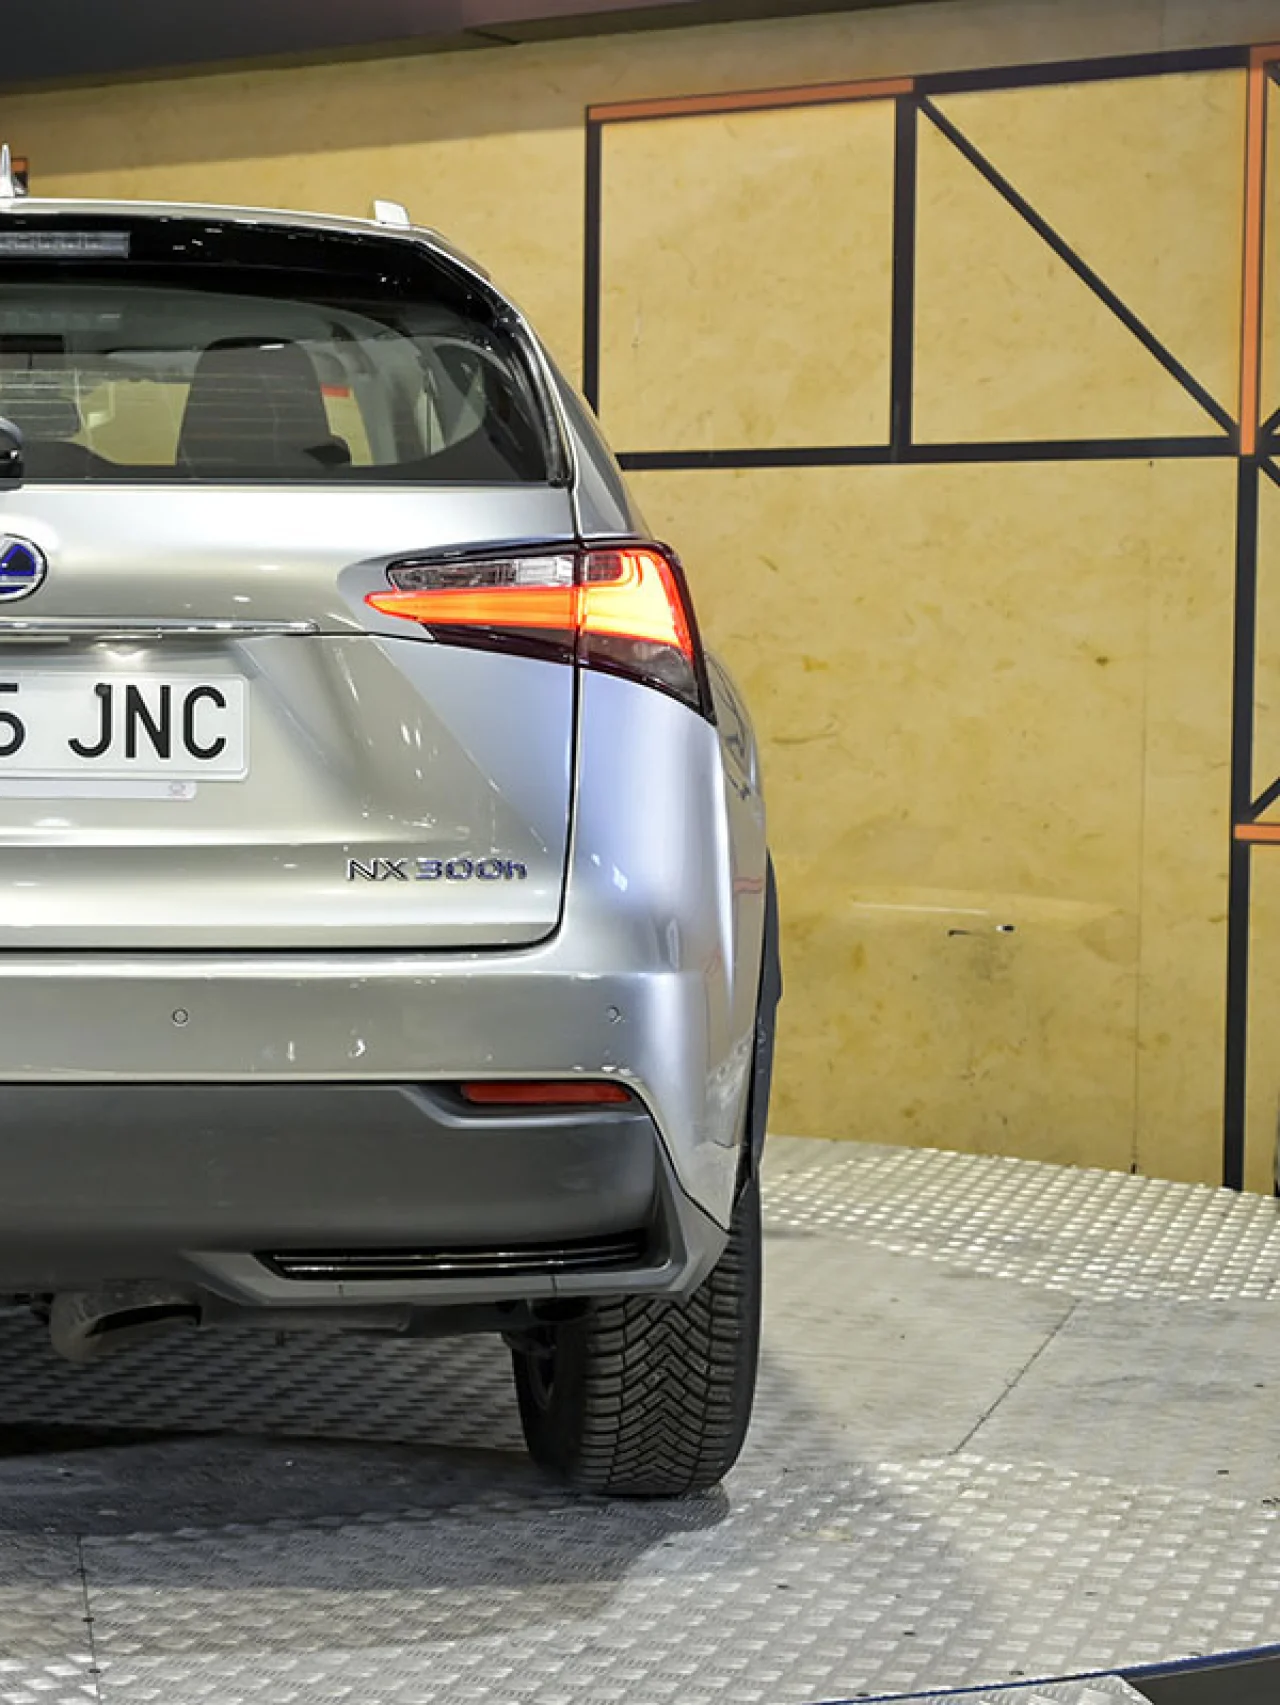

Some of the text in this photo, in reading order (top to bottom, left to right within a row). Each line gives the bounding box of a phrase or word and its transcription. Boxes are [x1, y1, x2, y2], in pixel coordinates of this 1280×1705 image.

[67, 682, 227, 760] JNC
[346, 857, 528, 881] NX 300h
